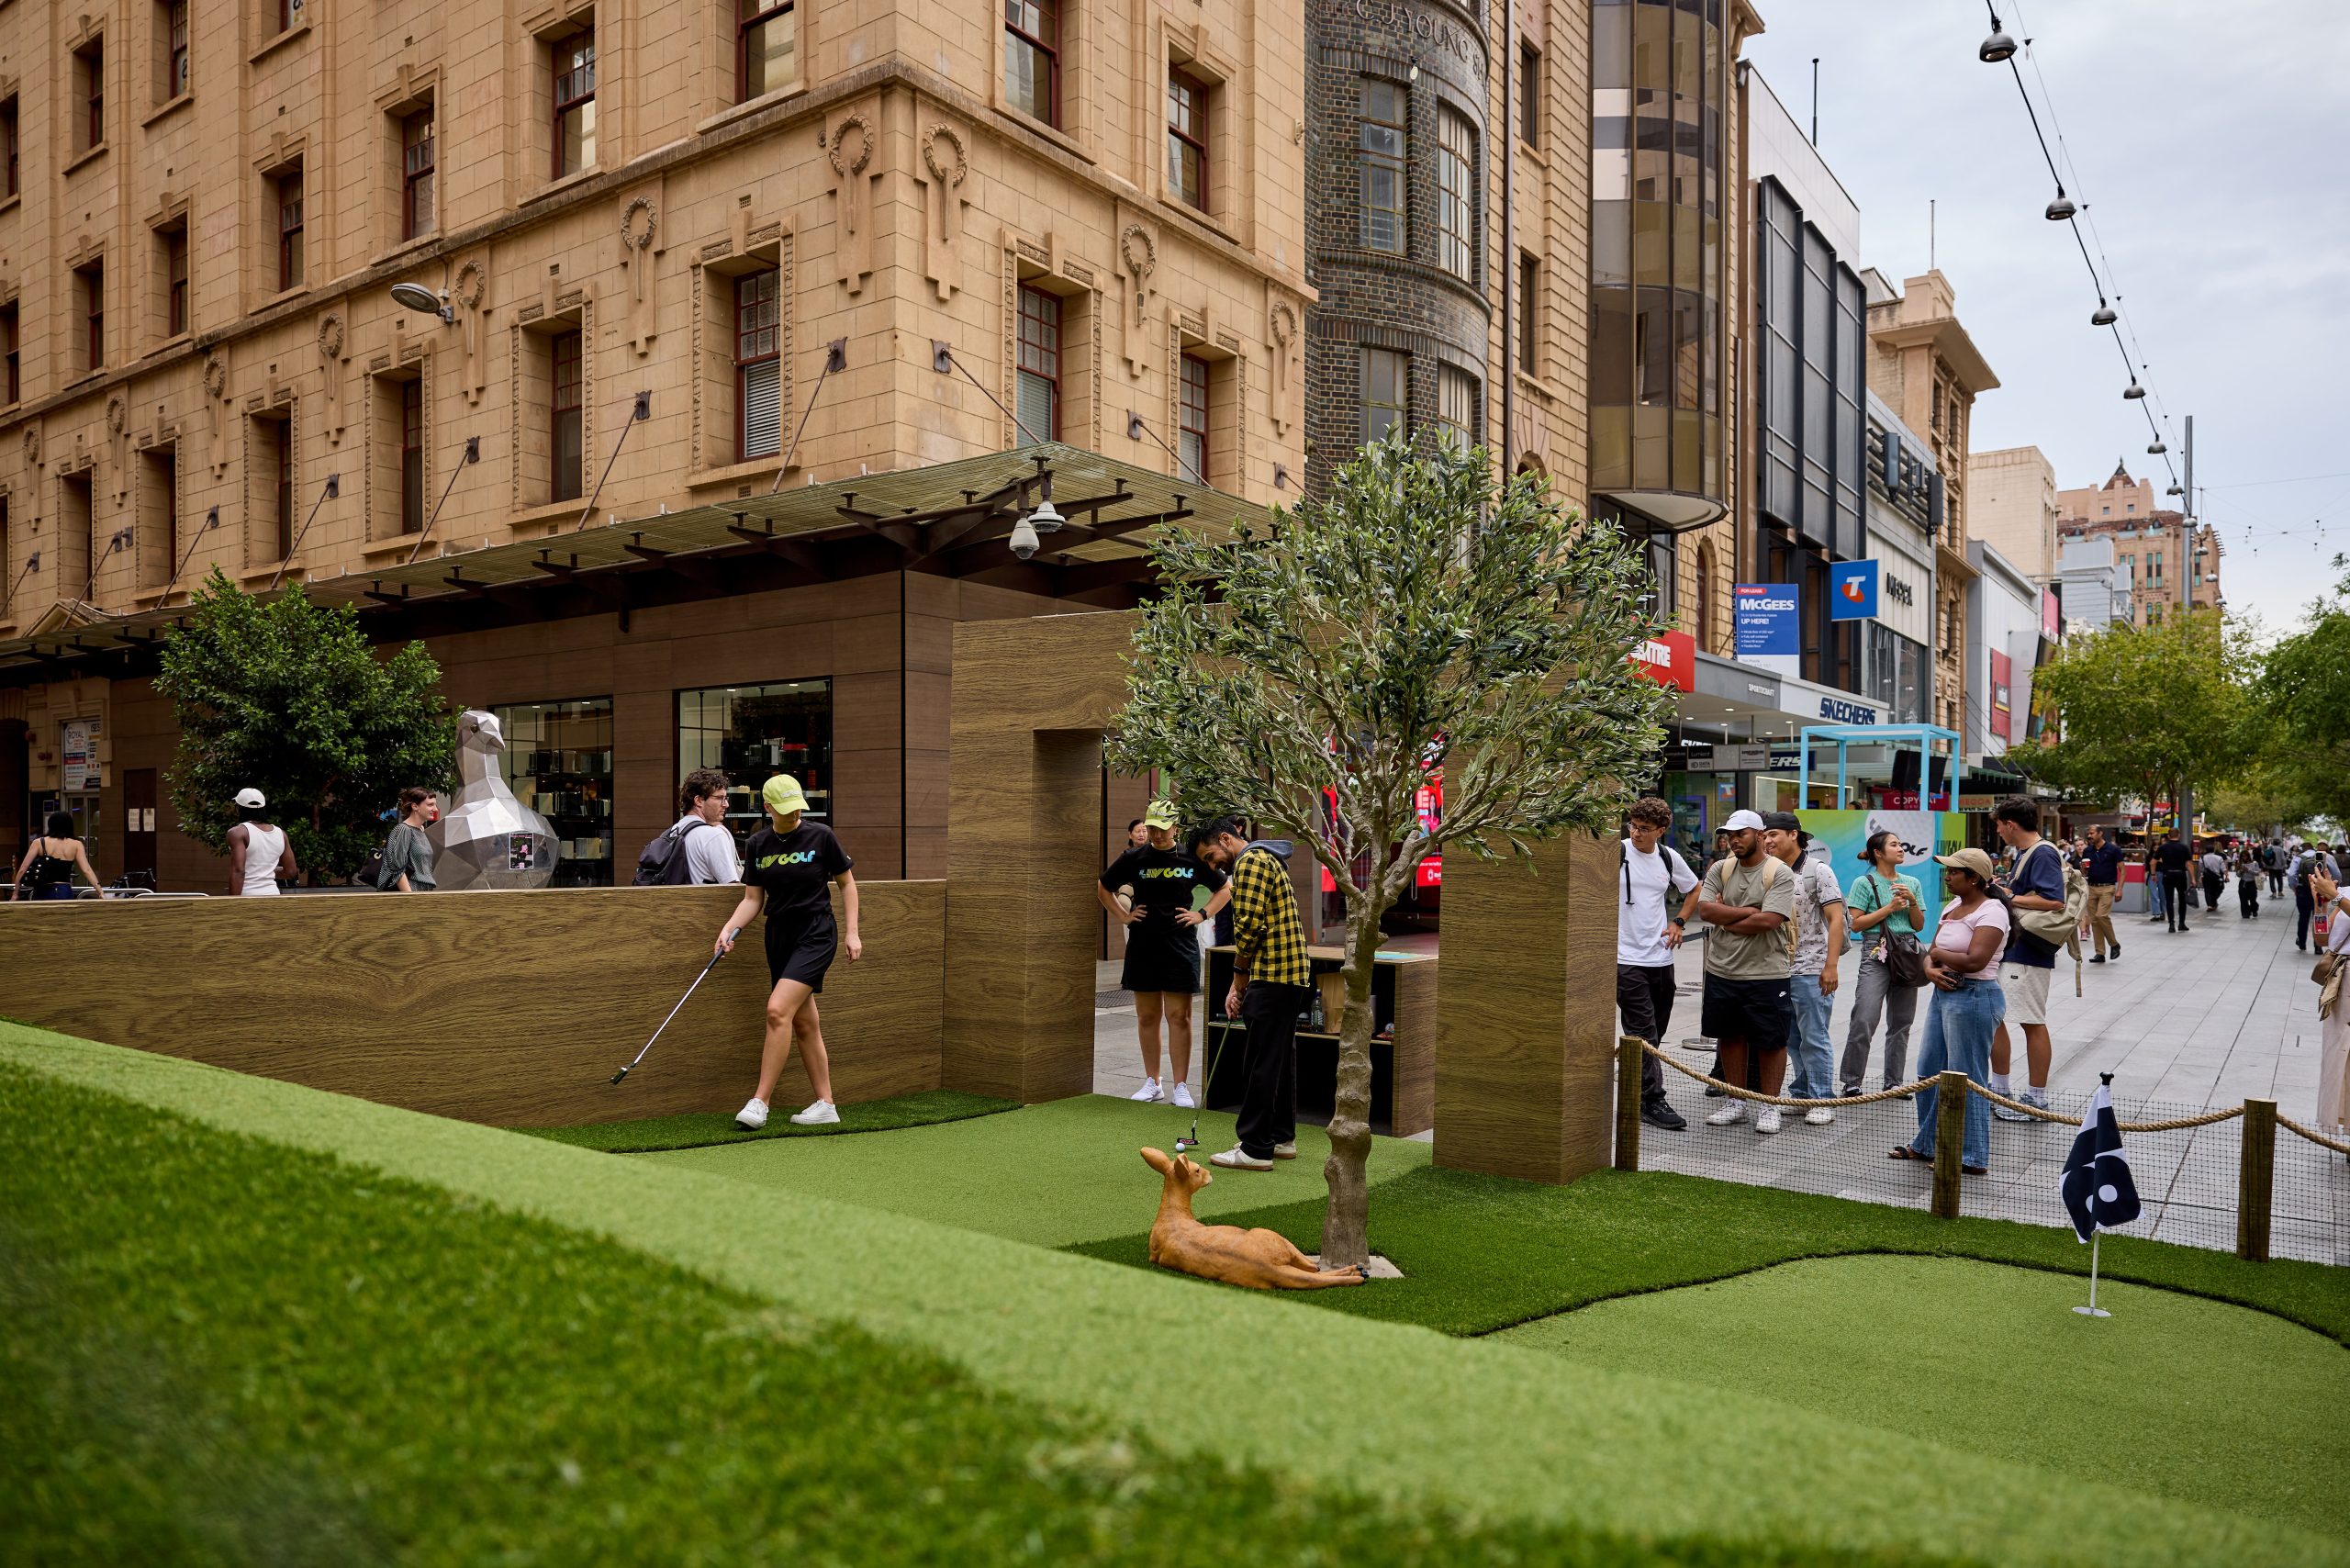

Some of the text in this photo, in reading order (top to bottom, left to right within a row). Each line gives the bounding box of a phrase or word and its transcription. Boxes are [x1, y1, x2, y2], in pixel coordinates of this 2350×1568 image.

[1403, 6, 1469, 63] YOUNG
[1629, 639, 1671, 668] ENTRE
[1819, 697, 1876, 725] SKECHERS
[778, 850, 816, 865] GOLF
[1163, 868, 1193, 878] GOLF
